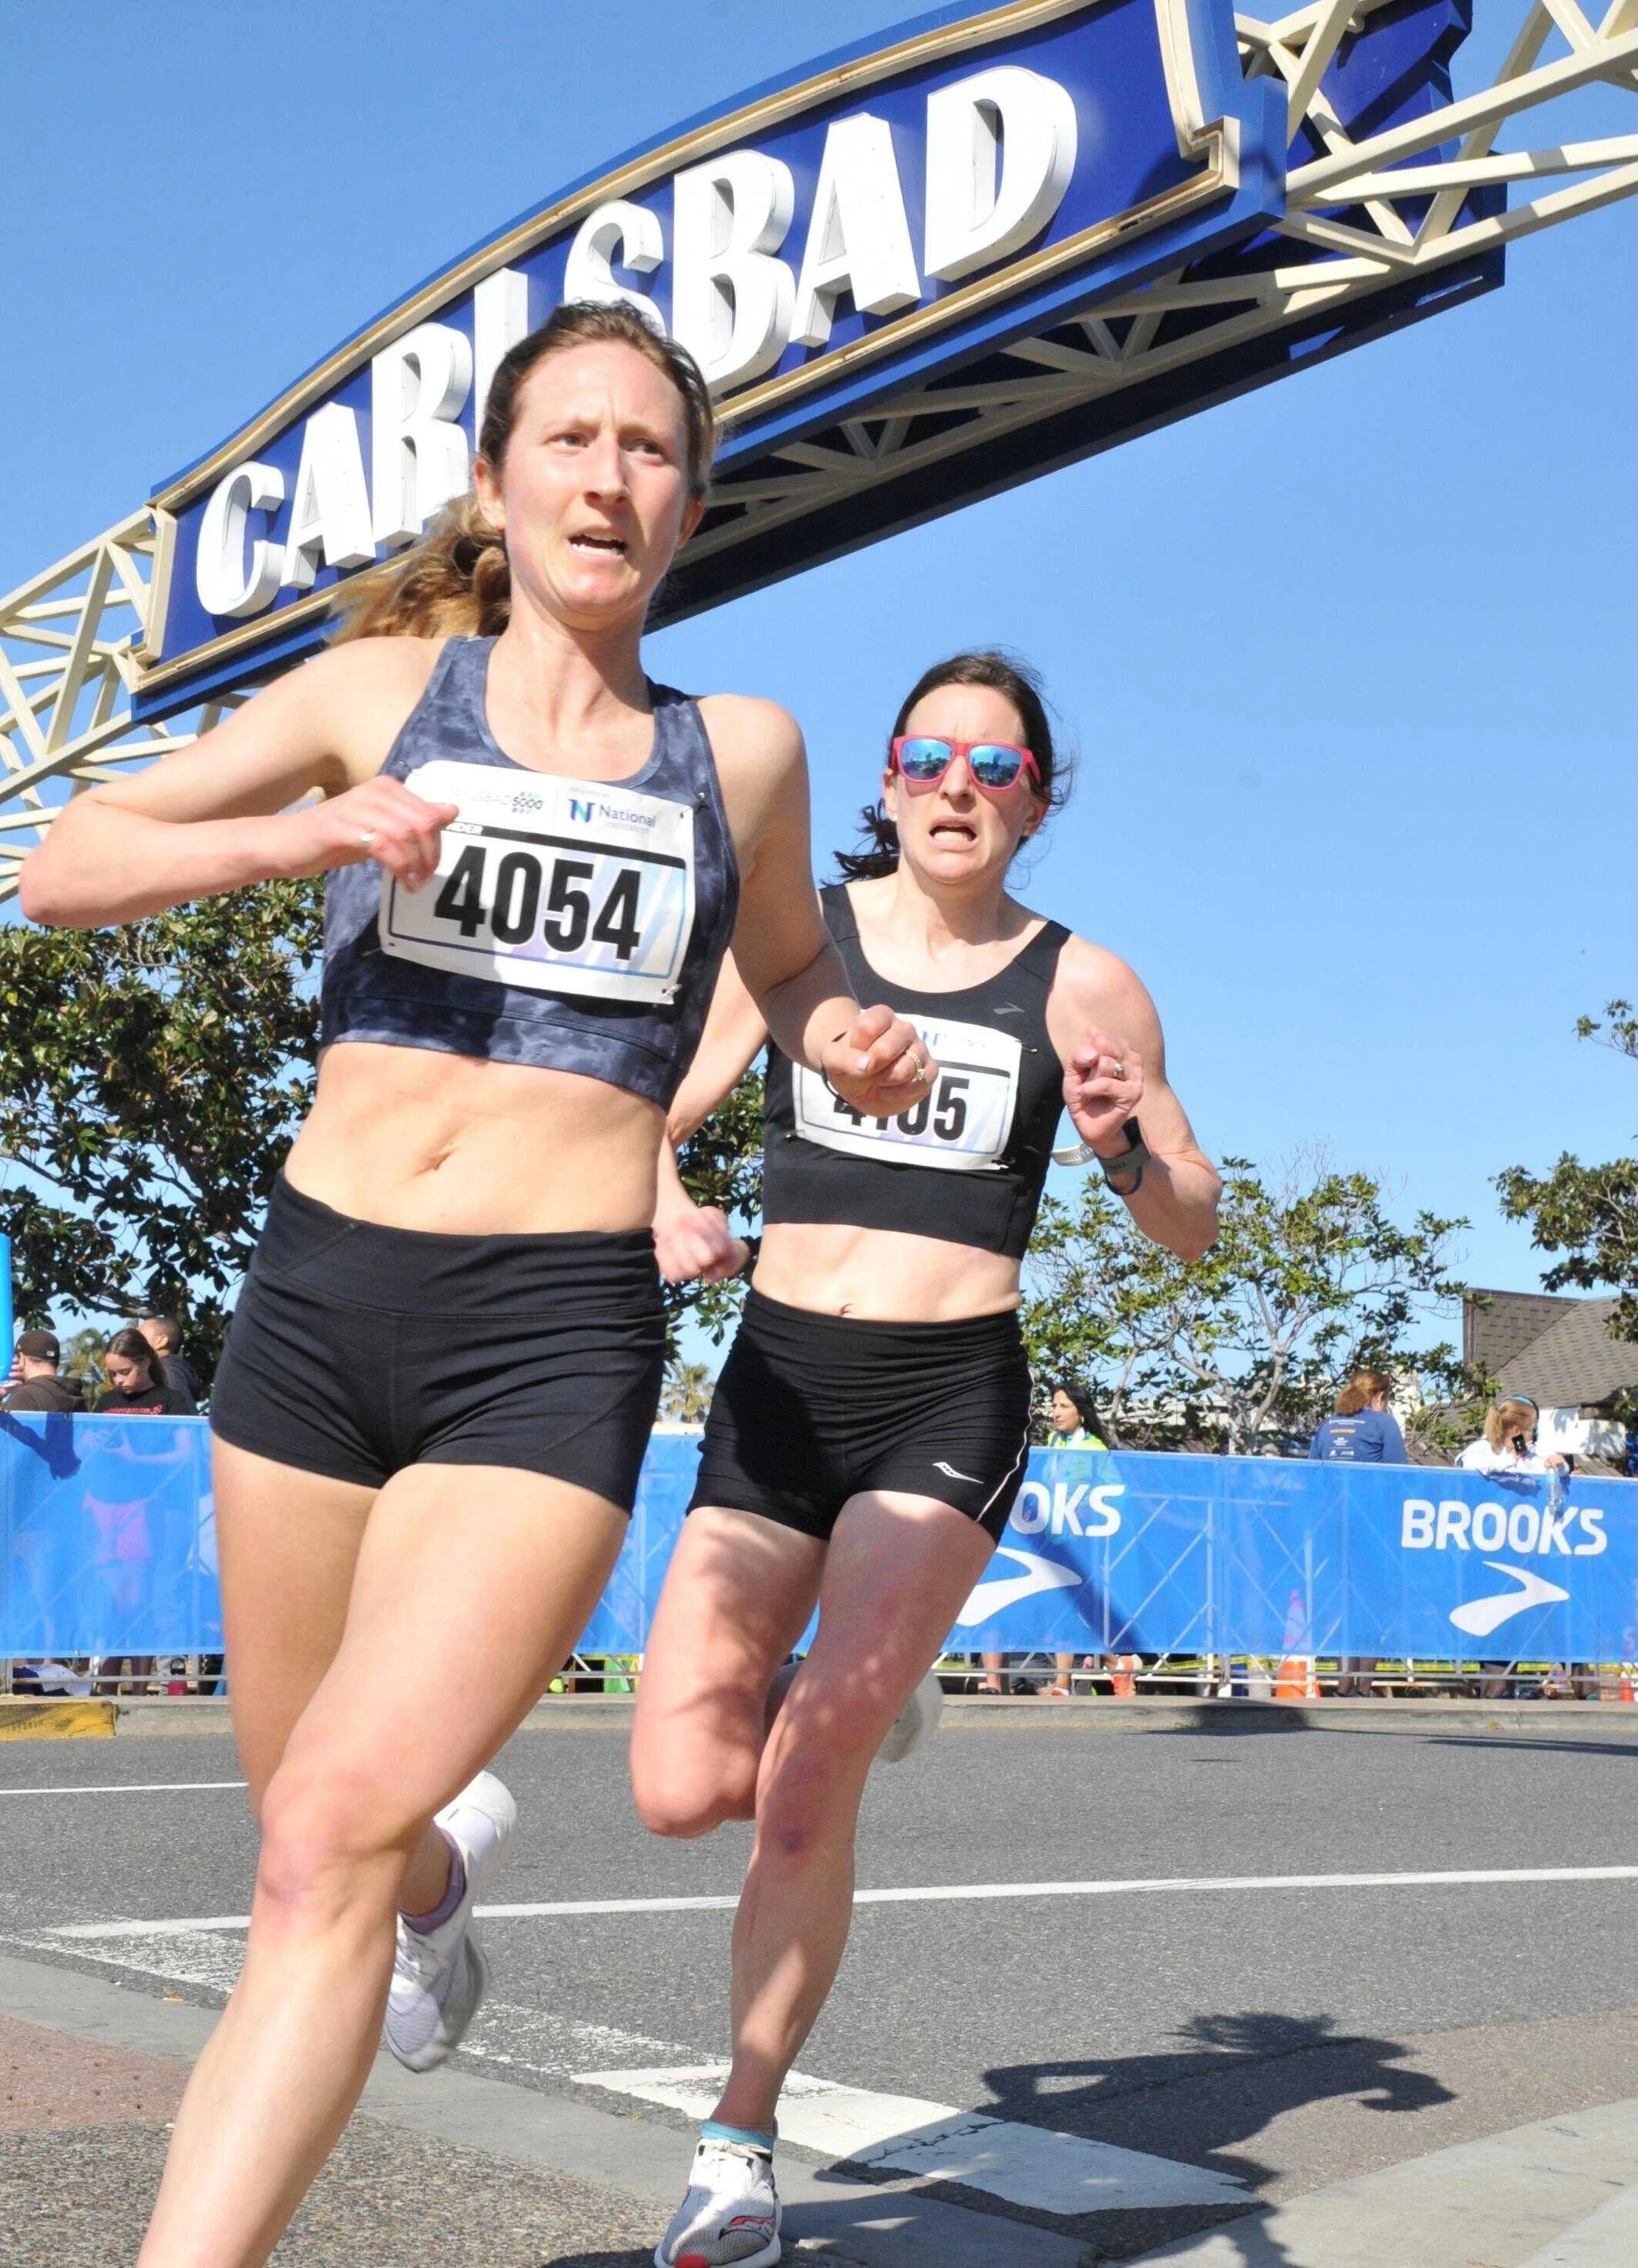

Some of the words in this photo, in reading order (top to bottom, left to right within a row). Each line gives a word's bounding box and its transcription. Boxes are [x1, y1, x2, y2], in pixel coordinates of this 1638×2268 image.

[599, 803, 658, 829] National
[433, 844, 642, 961] 4054
[833, 1075, 970, 1141] 05
[1009, 1480, 1126, 1538] OKS
[1401, 1499, 1609, 1556] BROOKS
